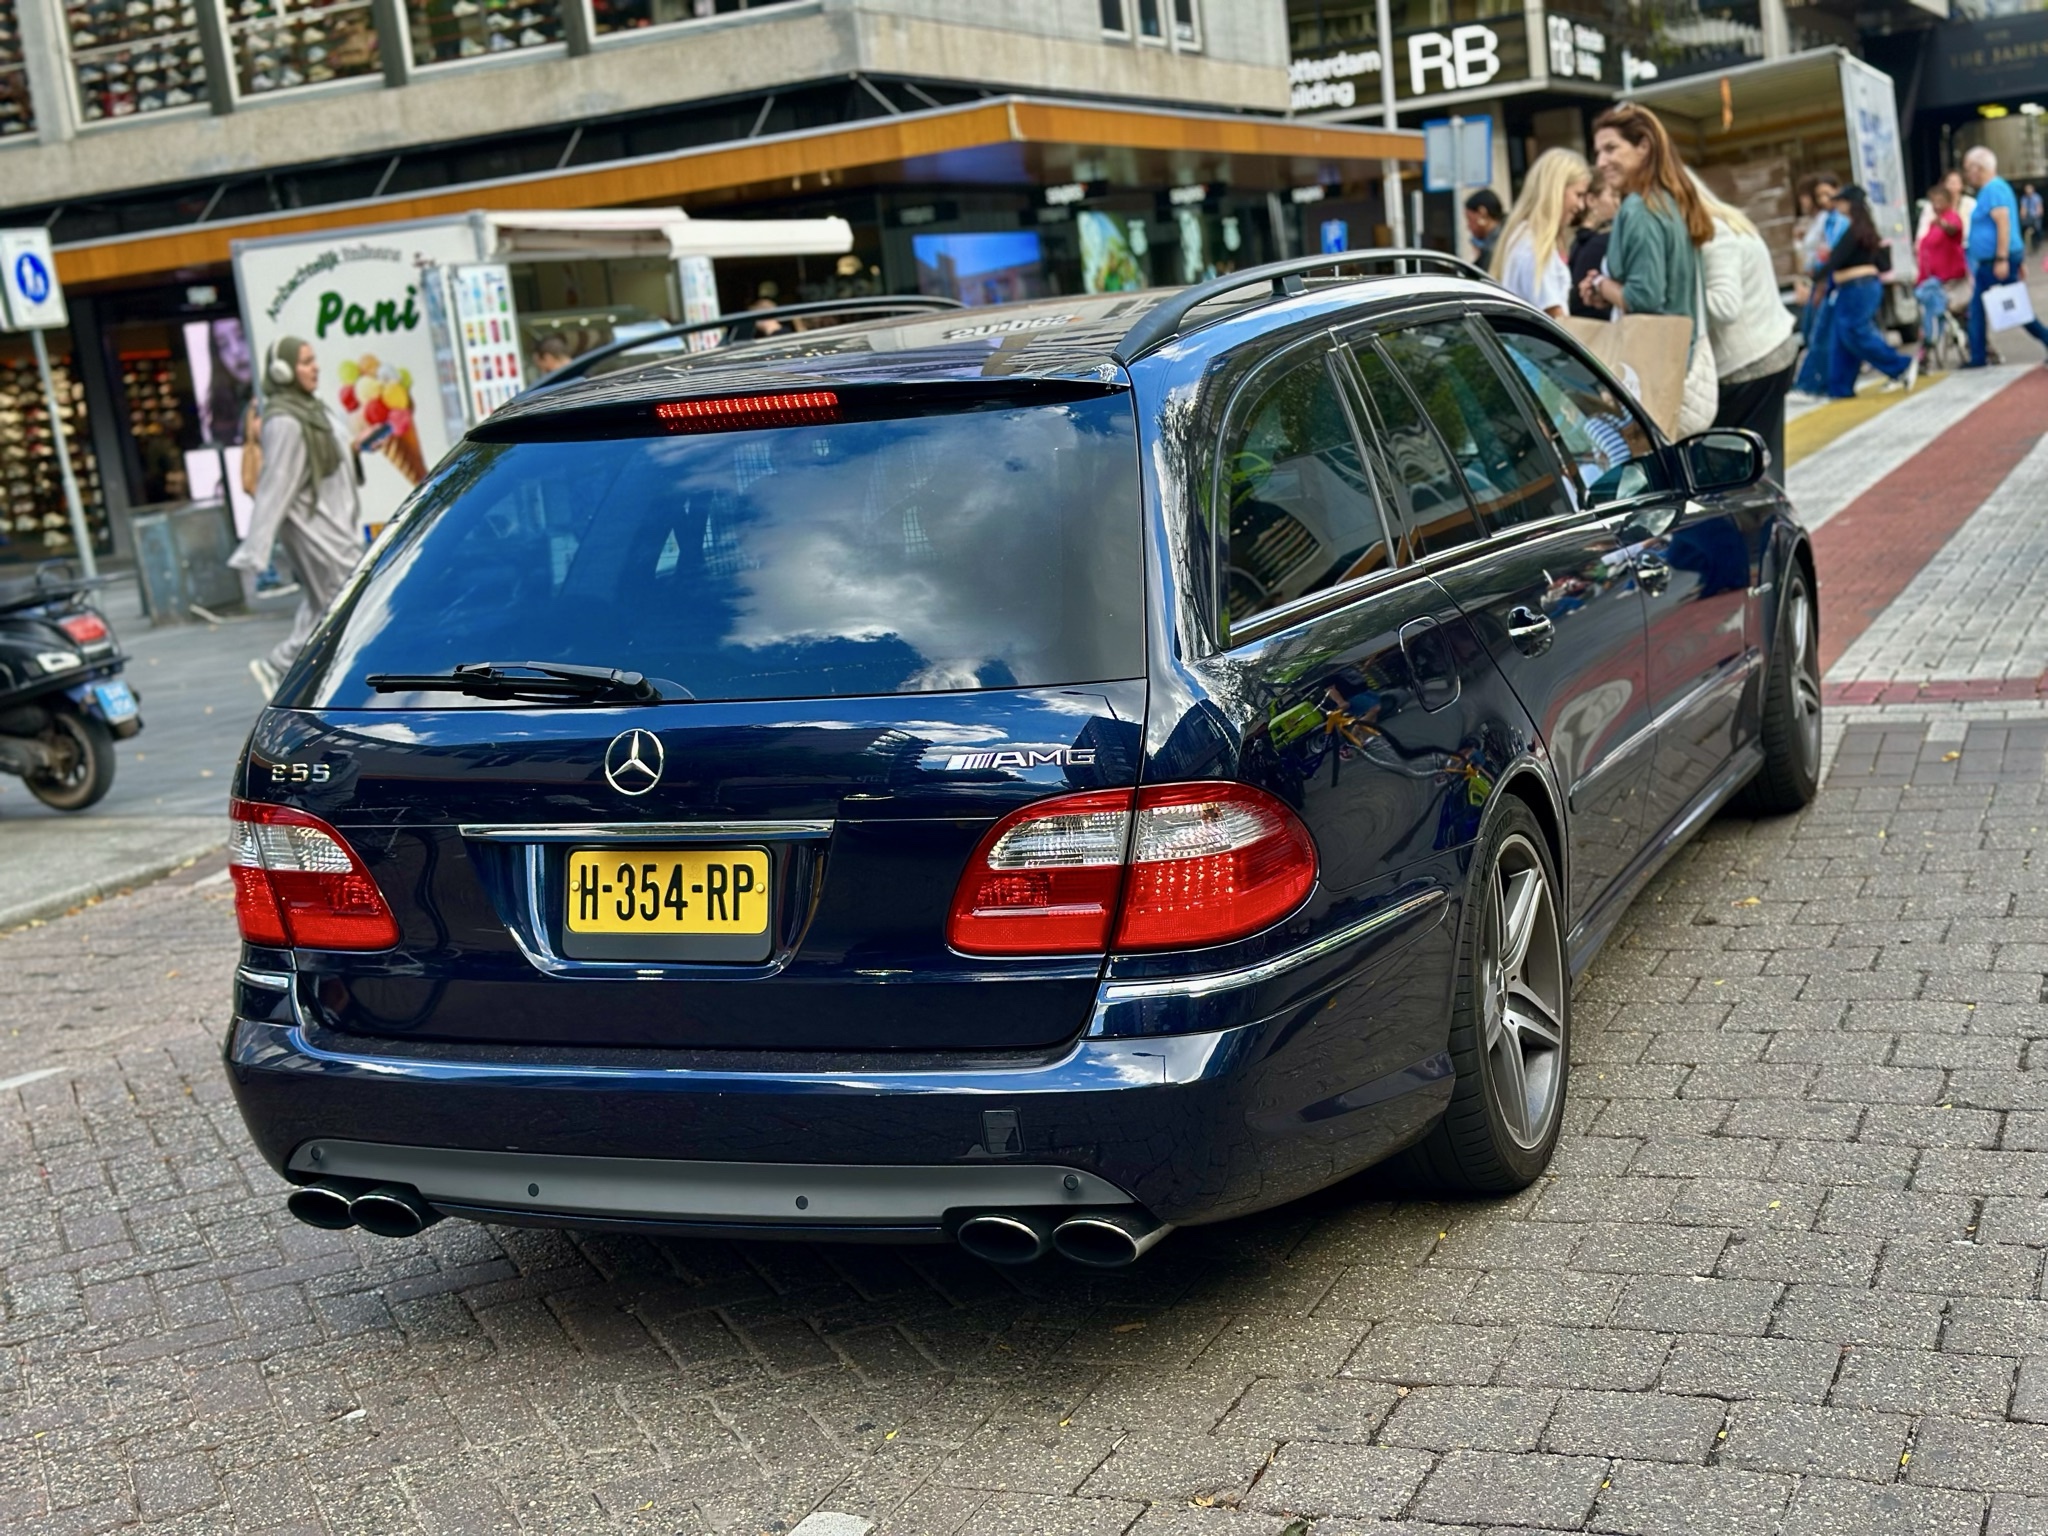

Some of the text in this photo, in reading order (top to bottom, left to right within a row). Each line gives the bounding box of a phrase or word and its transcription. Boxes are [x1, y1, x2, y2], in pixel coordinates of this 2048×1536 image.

[1408, 25, 1500, 94] RB
[315, 285, 420, 339] Pani
[991, 748, 1096, 769] AMG
[579, 862, 755, 921] H-354-RP
